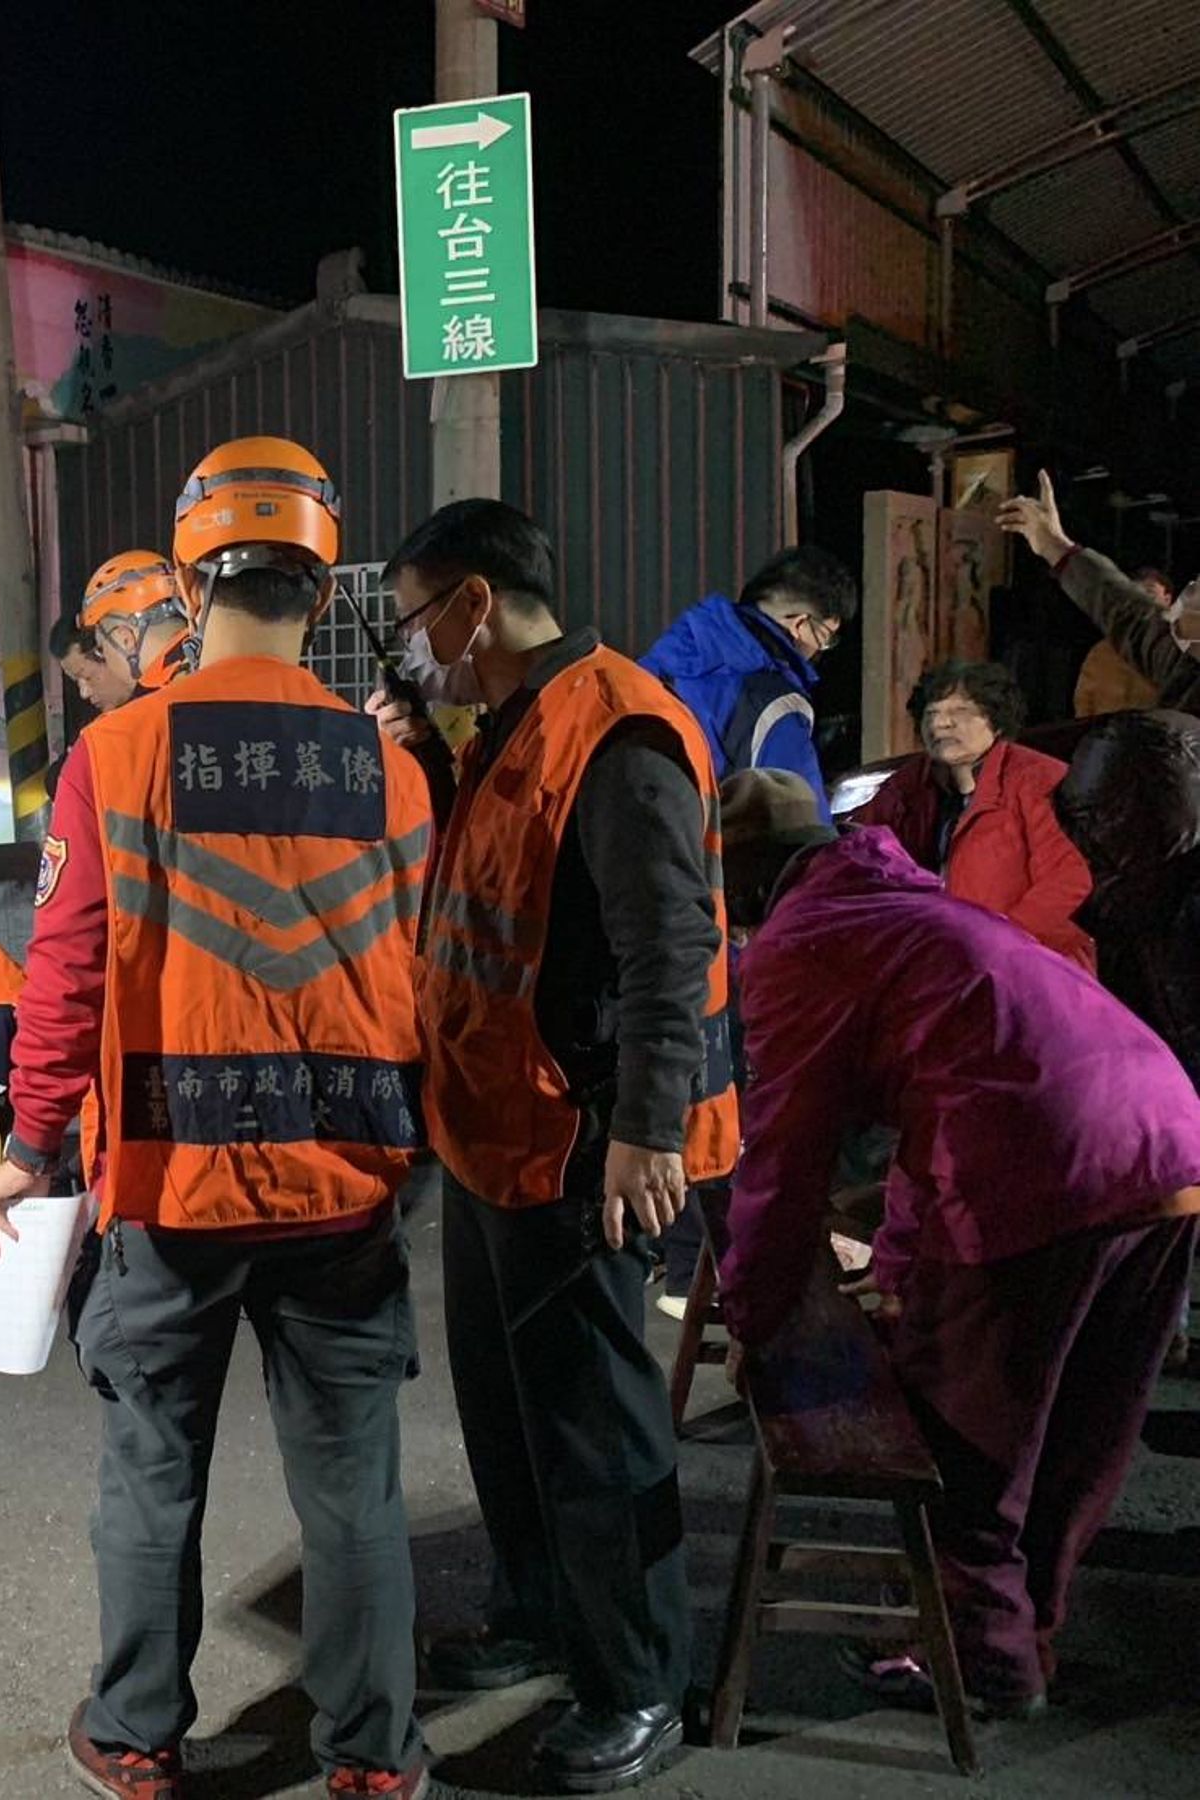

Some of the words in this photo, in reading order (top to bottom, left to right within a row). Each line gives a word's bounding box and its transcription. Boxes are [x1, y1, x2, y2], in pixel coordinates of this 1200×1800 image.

[436, 160, 497, 363] 往台三線
[177, 740, 383, 794] 指揮幕僚
